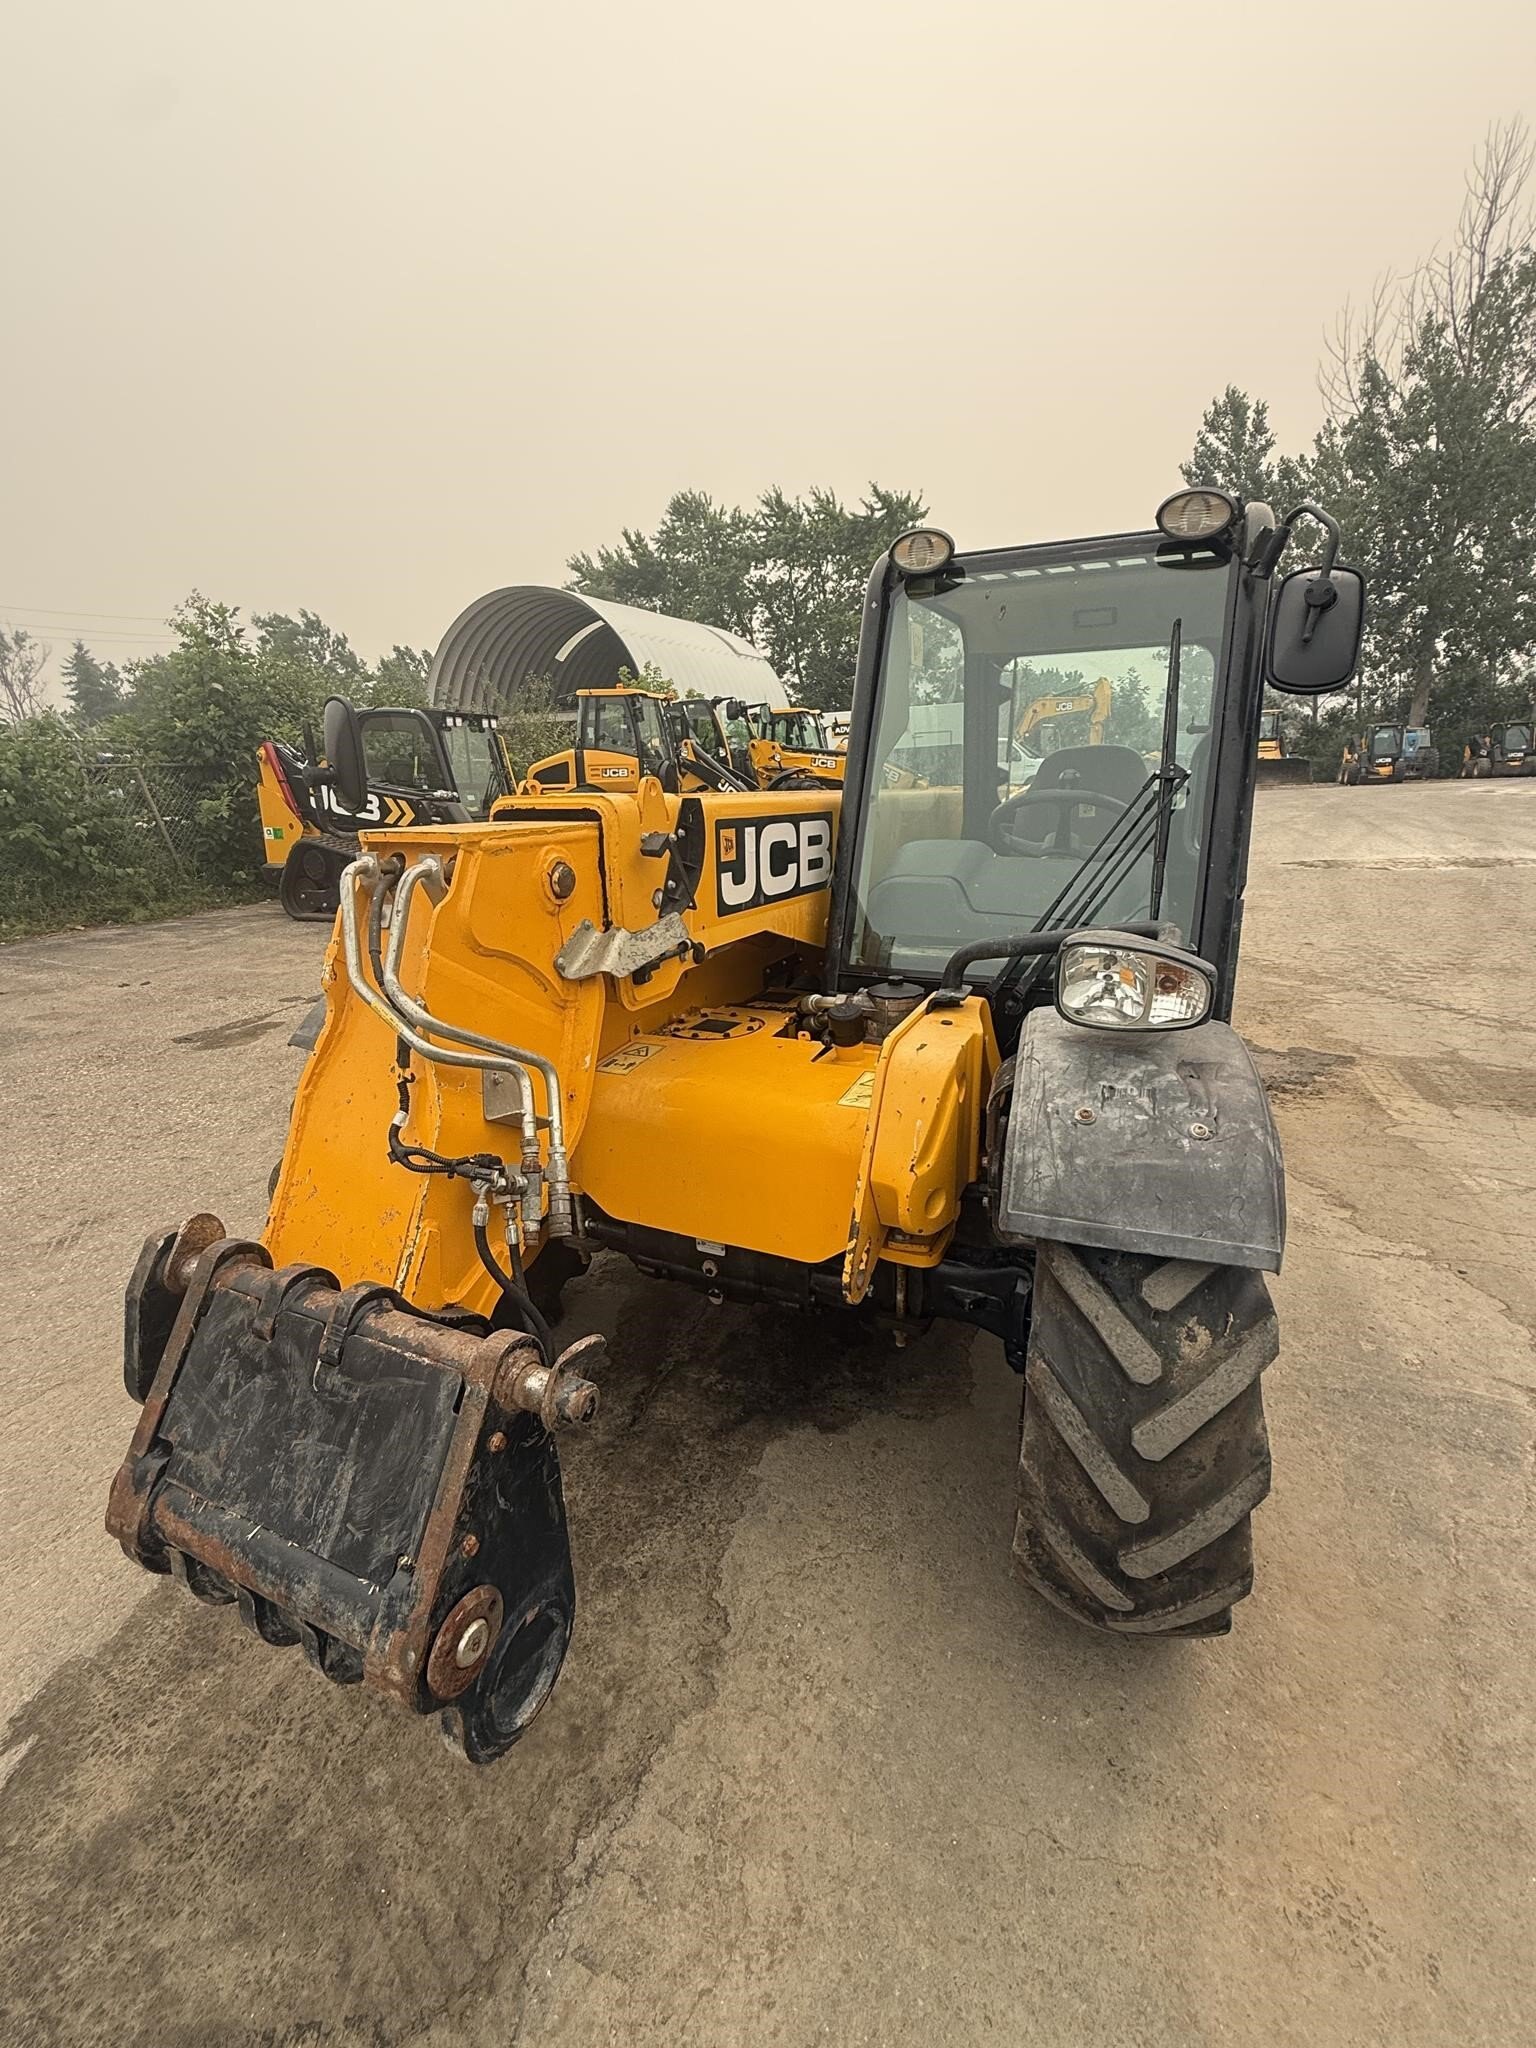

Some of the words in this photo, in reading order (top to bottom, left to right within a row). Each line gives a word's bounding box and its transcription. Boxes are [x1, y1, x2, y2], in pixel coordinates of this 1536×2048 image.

[1055, 702, 1073, 711] JCB
[811, 757, 836, 769] JCB
[602, 768, 628, 777] JCB
[720, 820, 831, 906] JCB
